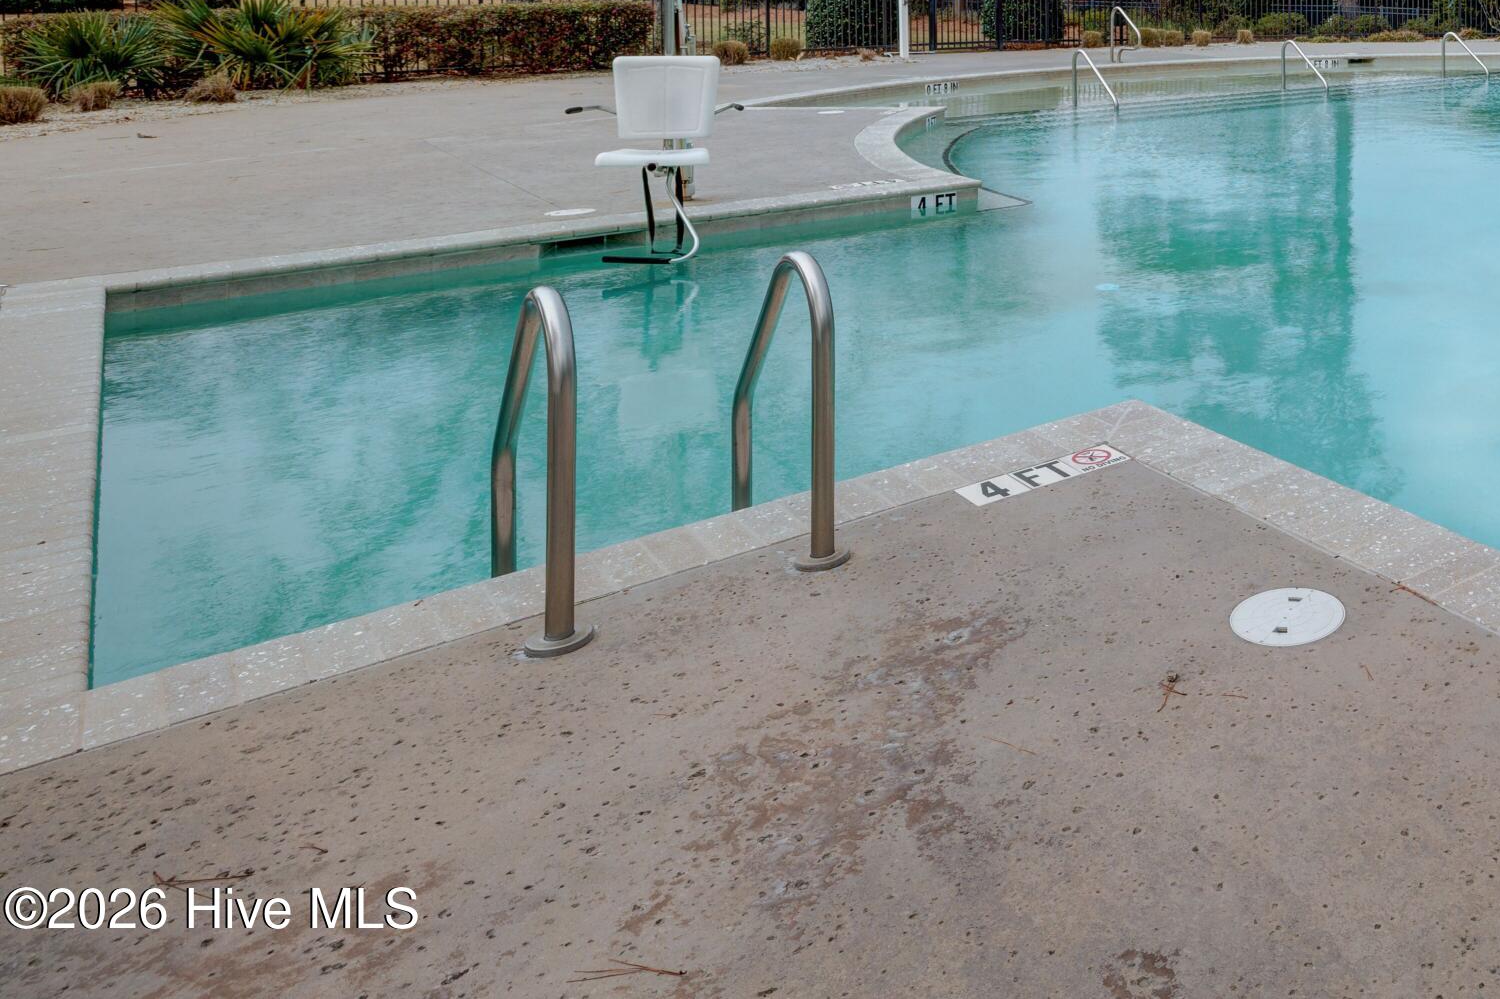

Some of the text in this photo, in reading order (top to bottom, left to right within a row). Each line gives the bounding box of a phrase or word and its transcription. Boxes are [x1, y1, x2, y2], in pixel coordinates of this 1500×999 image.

[935, 193, 956, 211] FT
[1096, 455, 1127, 468] DIVING
[980, 460, 1071, 498] 4 FT
